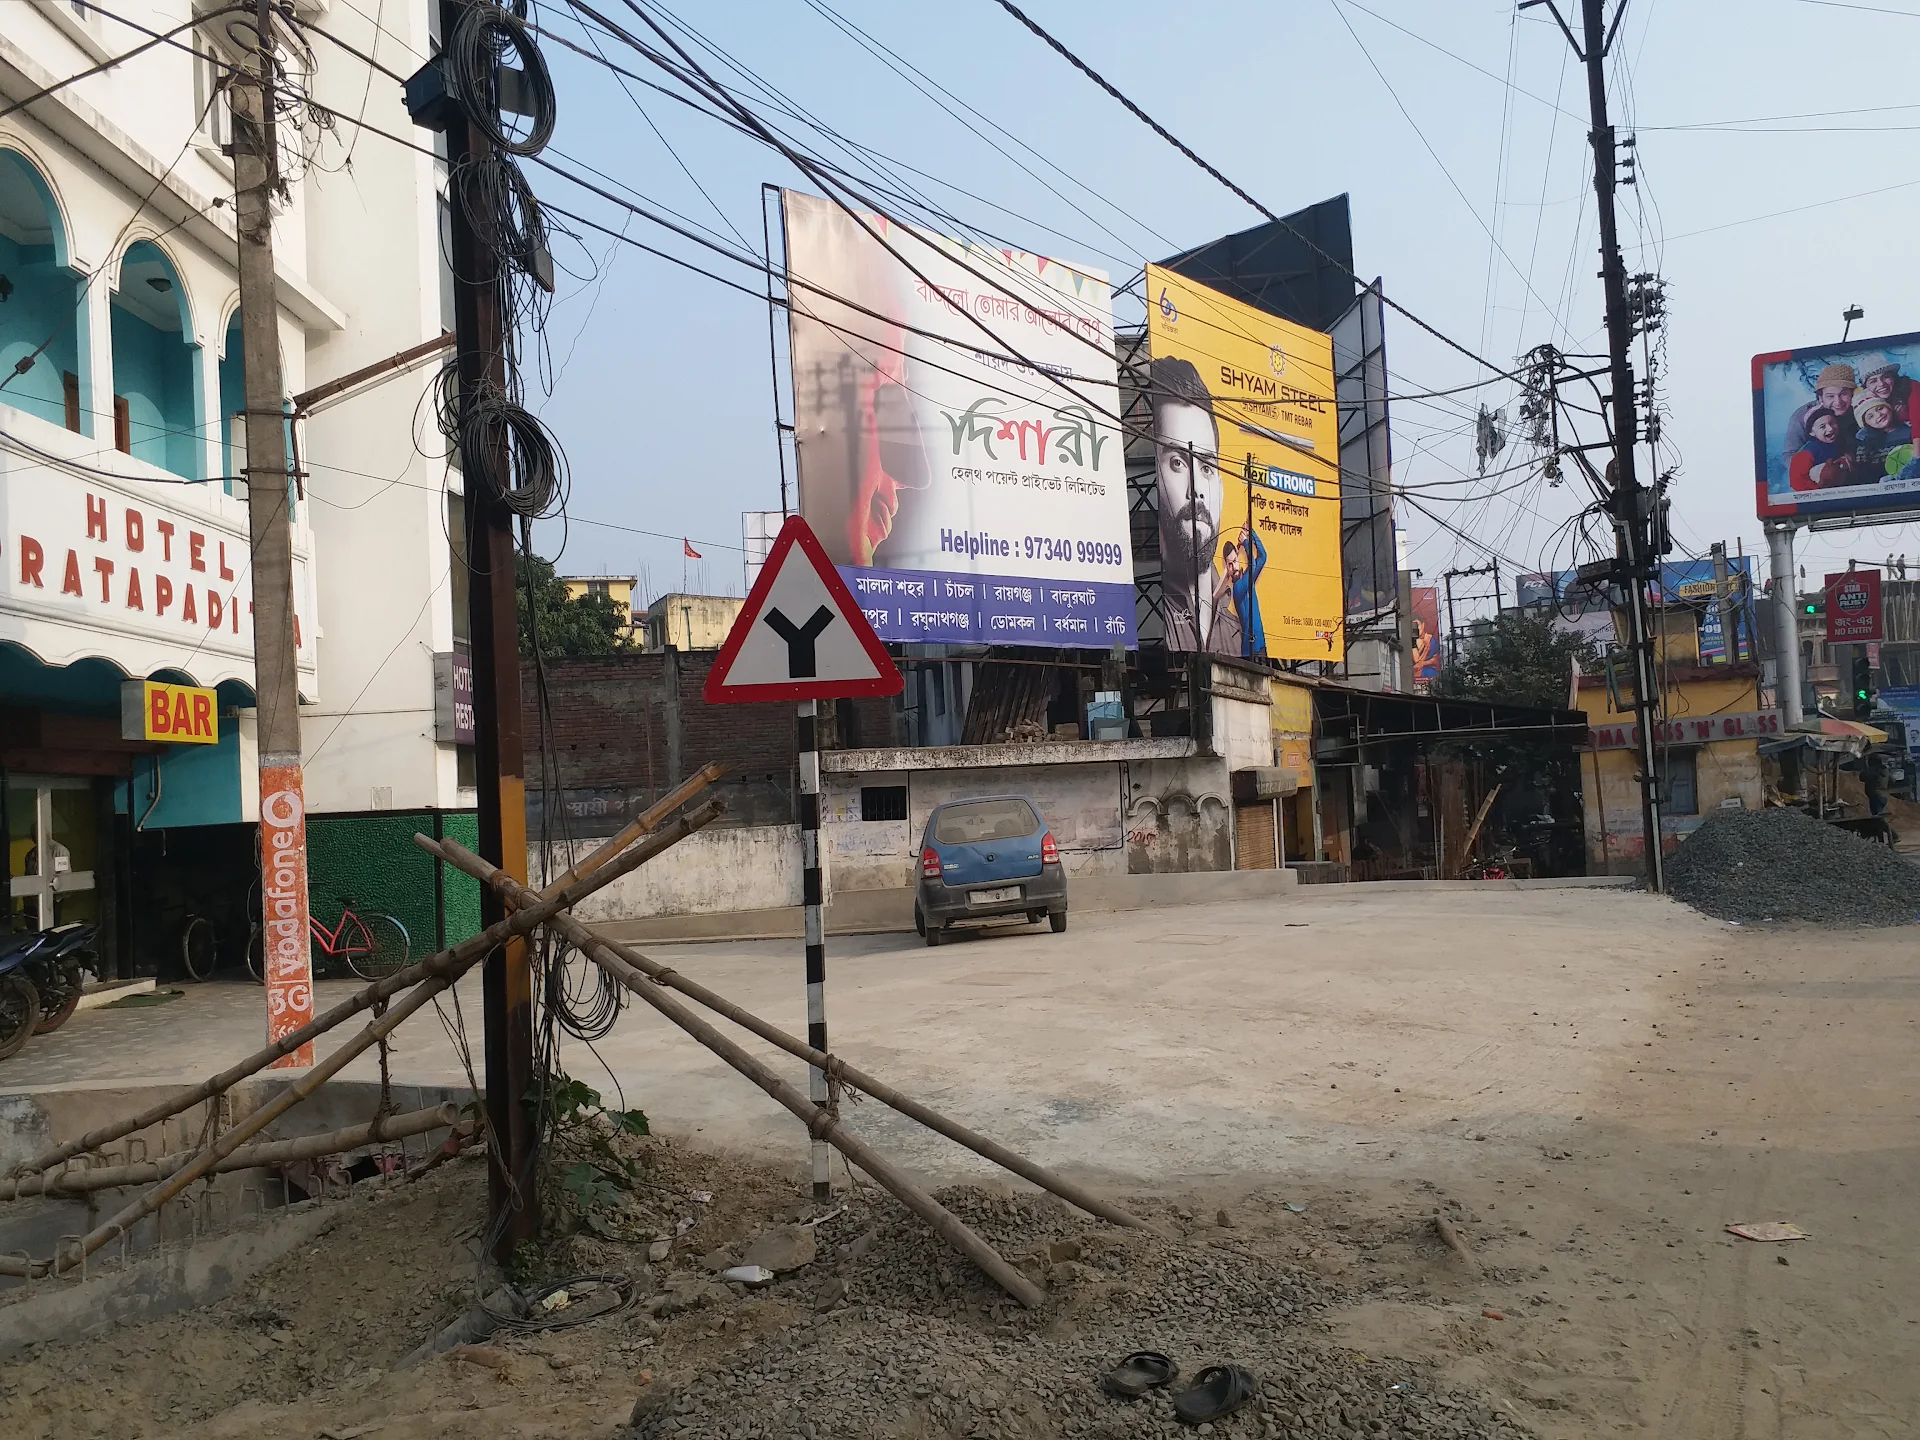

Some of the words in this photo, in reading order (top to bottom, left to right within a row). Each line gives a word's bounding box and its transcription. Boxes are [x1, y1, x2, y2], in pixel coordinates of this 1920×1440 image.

[974, 294, 1020, 322] তোমার
[1221, 366, 1276, 399] SHYAM
[1281, 385, 1326, 414] STEEL
[1281, 410, 1293, 423] TMT
[1295, 414, 1313, 429] REBAR
[940, 397, 1109, 472] দিশারী
[1021, 473, 1062, 492] প্রাইভেট
[1064, 476, 1106, 497] লিমিটেড
[1269, 500, 1275, 510] ও
[1276, 498, 1310, 518] নমনীয়তার
[86, 492, 234, 582] HOTEL
[1258, 516, 1277, 532] সঠিক
[940, 528, 1010, 560] Helpline
[1024, 535, 1072, 562] 97340
[1076, 540, 1122, 566] 99999
[0, 534, 303, 649] RATAPADIA
[856, 577, 894, 597] মালদা
[896, 580, 925, 599] শহর
[944, 578, 975, 600] চাঁচল
[993, 585, 1033, 606] রায়গঞ্জ
[1051, 587, 1096, 609] বালুরঘাট
[1840, 592, 1867, 601] ANTI
[1840, 599, 1867, 607] RUST
[910, 610, 970, 632] রঘুনাথগঞ্জ
[990, 615, 1036, 631] ডোমকল
[1053, 613, 1087, 633] বর্ধমান
[1104, 615, 1126, 636] রাঁচি
[1834, 615, 1873, 627] জং-এর
[1834, 627, 1846, 636] NO
[1848, 626, 1873, 635] ENTRY
[151, 689, 213, 737] BAR
[1724, 714, 1778, 737] GLASS
[267, 831, 297, 977] vodafone
